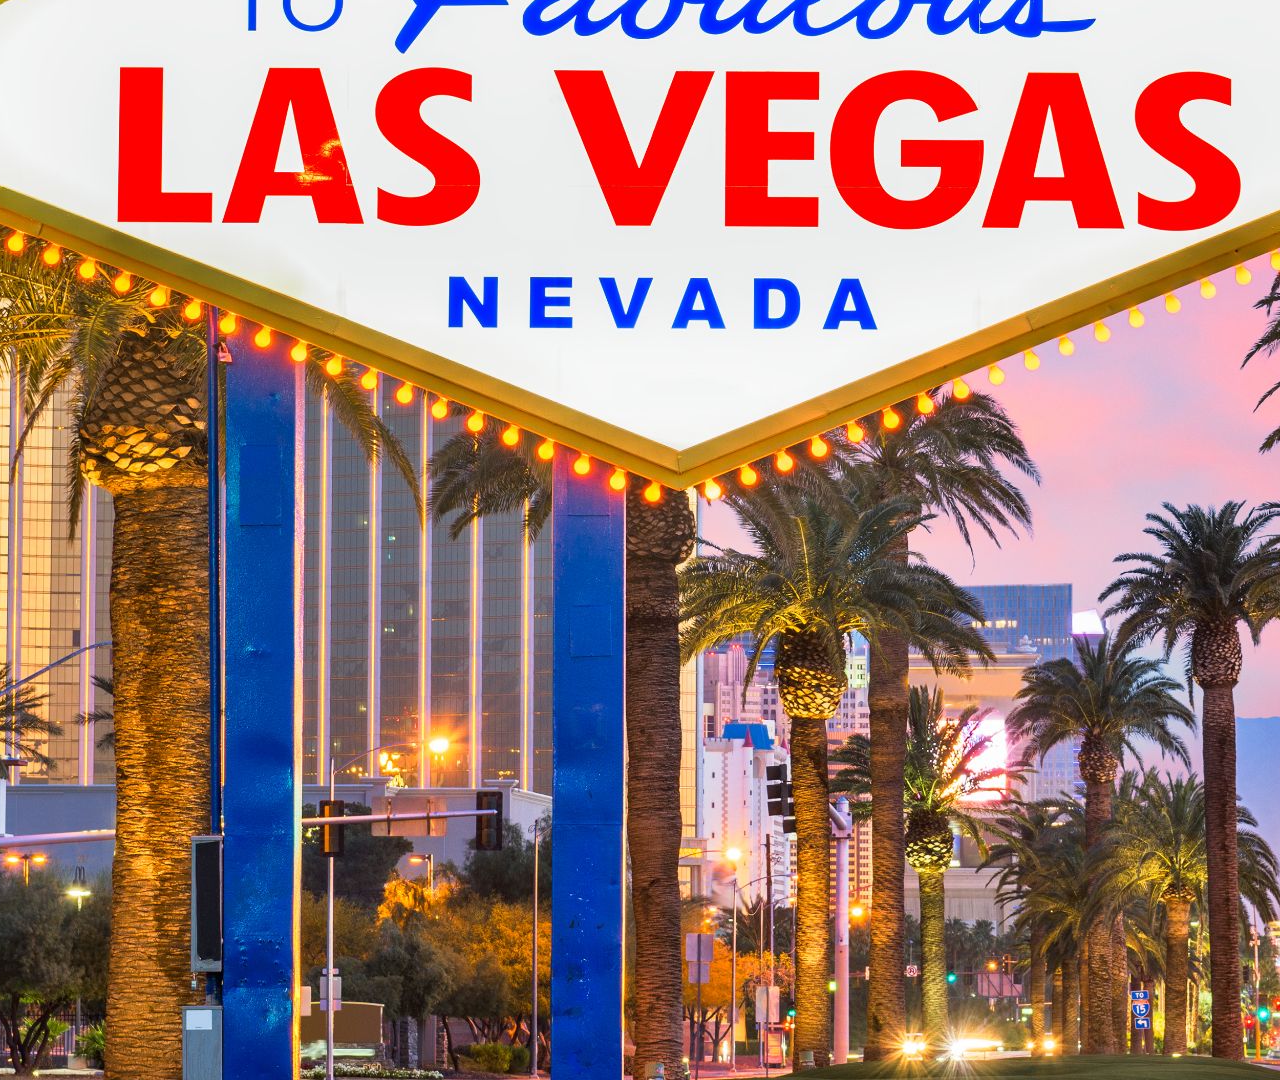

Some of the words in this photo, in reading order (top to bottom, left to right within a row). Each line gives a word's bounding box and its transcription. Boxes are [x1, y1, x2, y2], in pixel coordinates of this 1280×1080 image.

[117, 66, 481, 227] LAS
[555, 69, 1242, 232] VEGAS
[448, 276, 878, 330] NEVADA
[1136, 1005, 1146, 1014] 15
